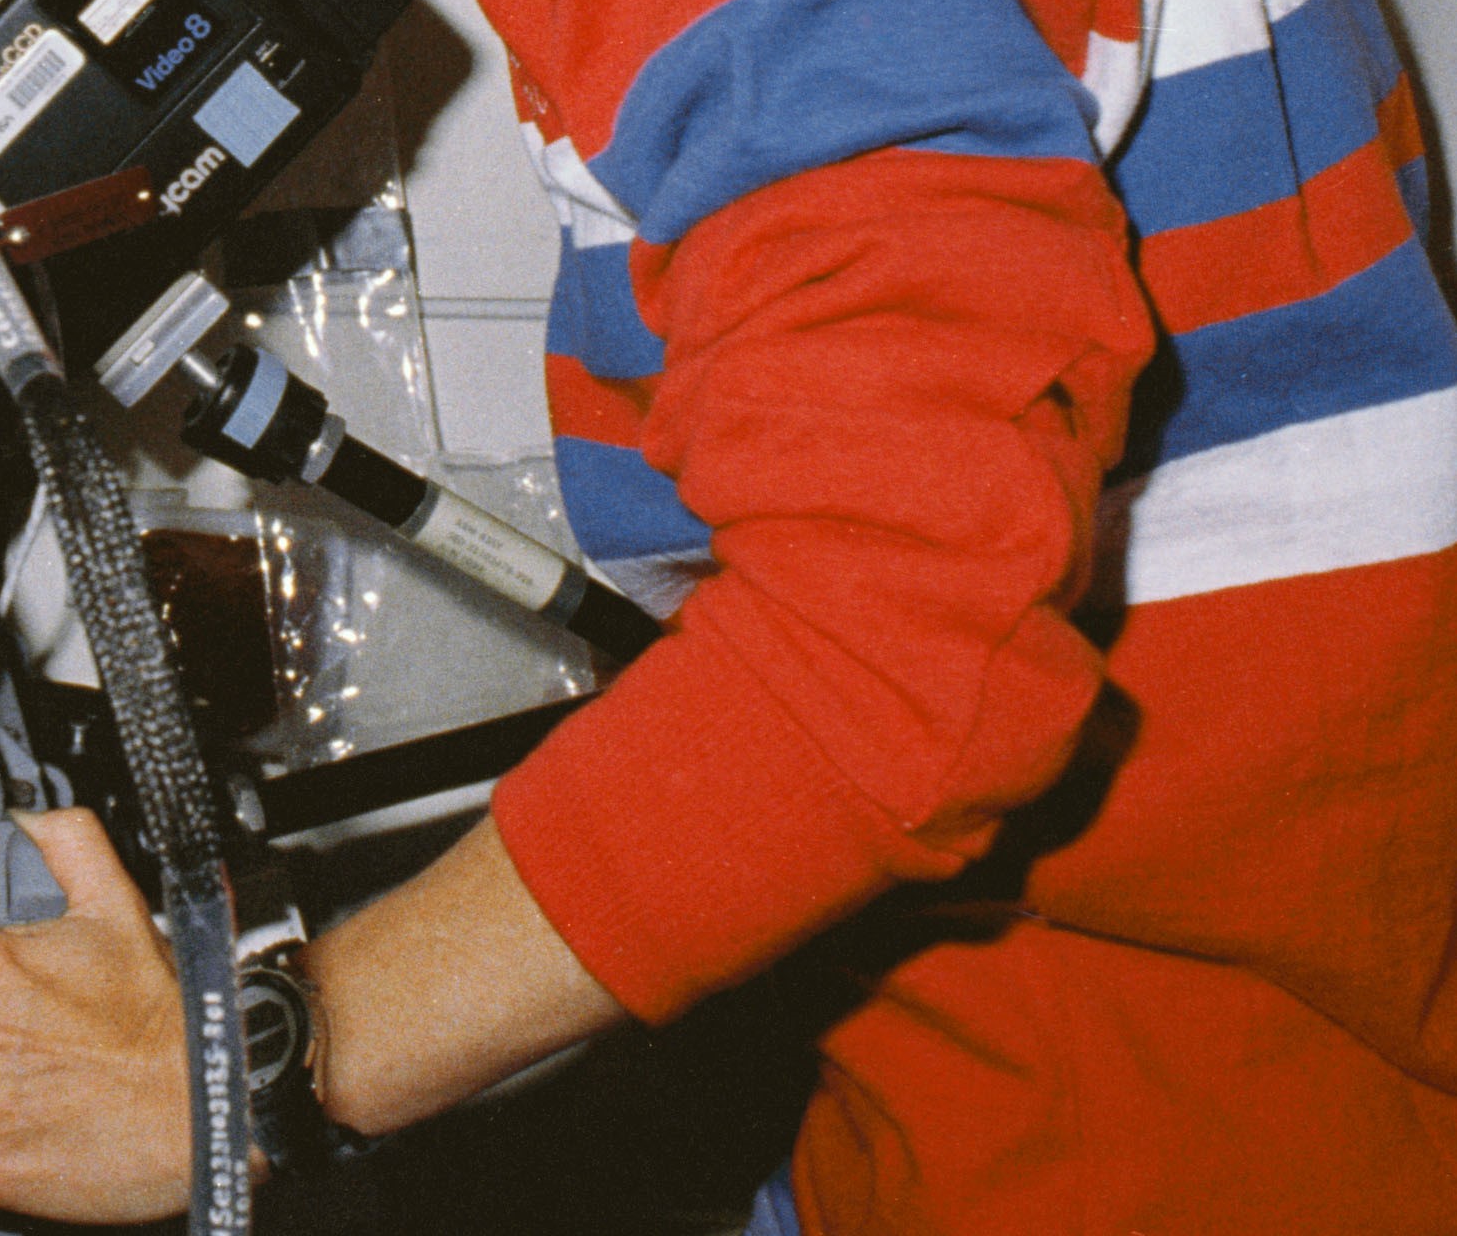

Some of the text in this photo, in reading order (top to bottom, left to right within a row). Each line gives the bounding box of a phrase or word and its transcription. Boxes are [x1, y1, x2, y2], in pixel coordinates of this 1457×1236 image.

[2, 22, 43, 64] CCD
[134, 13, 211, 90] Video 8
